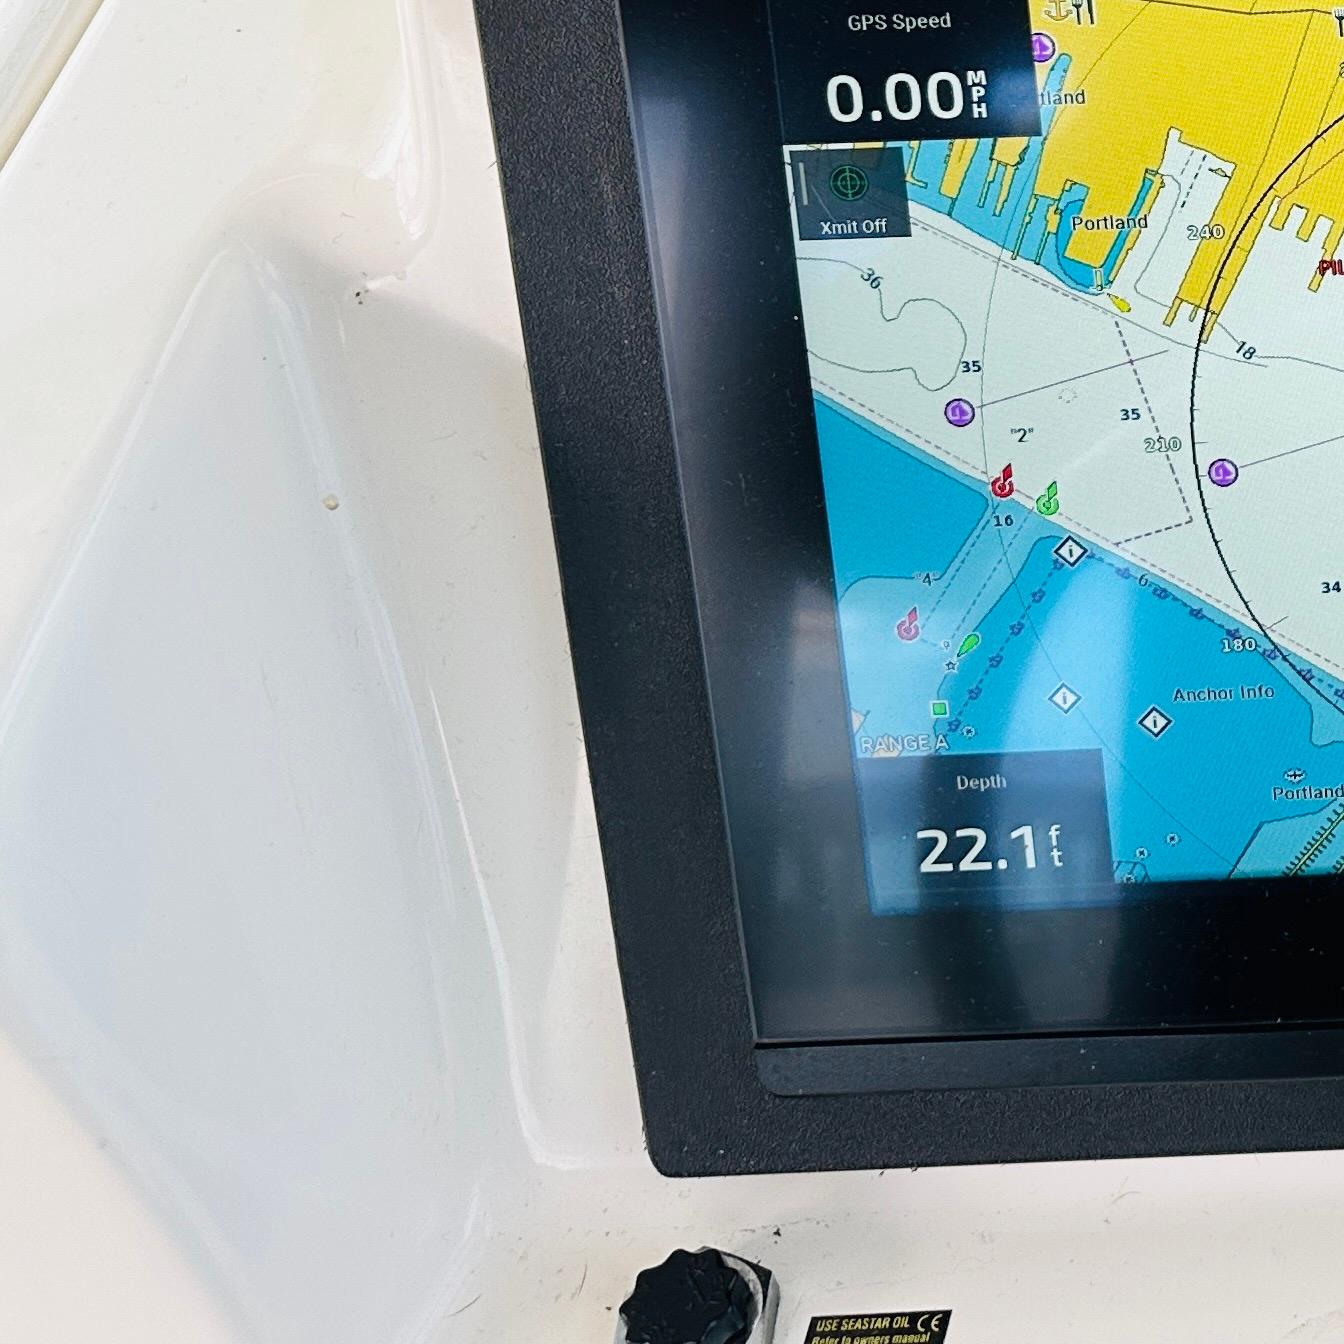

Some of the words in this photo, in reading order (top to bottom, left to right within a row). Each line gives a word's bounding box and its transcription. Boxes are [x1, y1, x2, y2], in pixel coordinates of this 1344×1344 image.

[848, 14, 887, 31] GPS
[893, 12, 952, 33] Speed
[826, 71, 965, 123] 0.00
[820, 220, 858, 234] Xmit
[863, 218, 887, 233] Off
[1072, 214, 1148, 232] Portland
[1186, 224, 1225, 241] 240
[860, 267, 884, 290] 36
[1234, 340, 1257, 360] 18
[961, 361, 981, 373] 35
[1120, 408, 1141, 421] 35
[1144, 437, 1182, 452] 210
[993, 514, 1014, 528] 16
[1321, 581, 1342, 593] 34
[1222, 638, 1256, 653] 180
[1173, 685, 1235, 703] Anchor
[1241, 684, 1275, 699] Info
[860, 735, 930, 752] RANGE
[956, 773, 1007, 792] Depth
[1272, 784, 1344, 800] Portland
[917, 825, 1037, 873] 22.1
[816, 1319, 840, 1332] USE
[841, 1317, 891, 1332] SEASTAR
[893, 1316, 910, 1328] OIL
